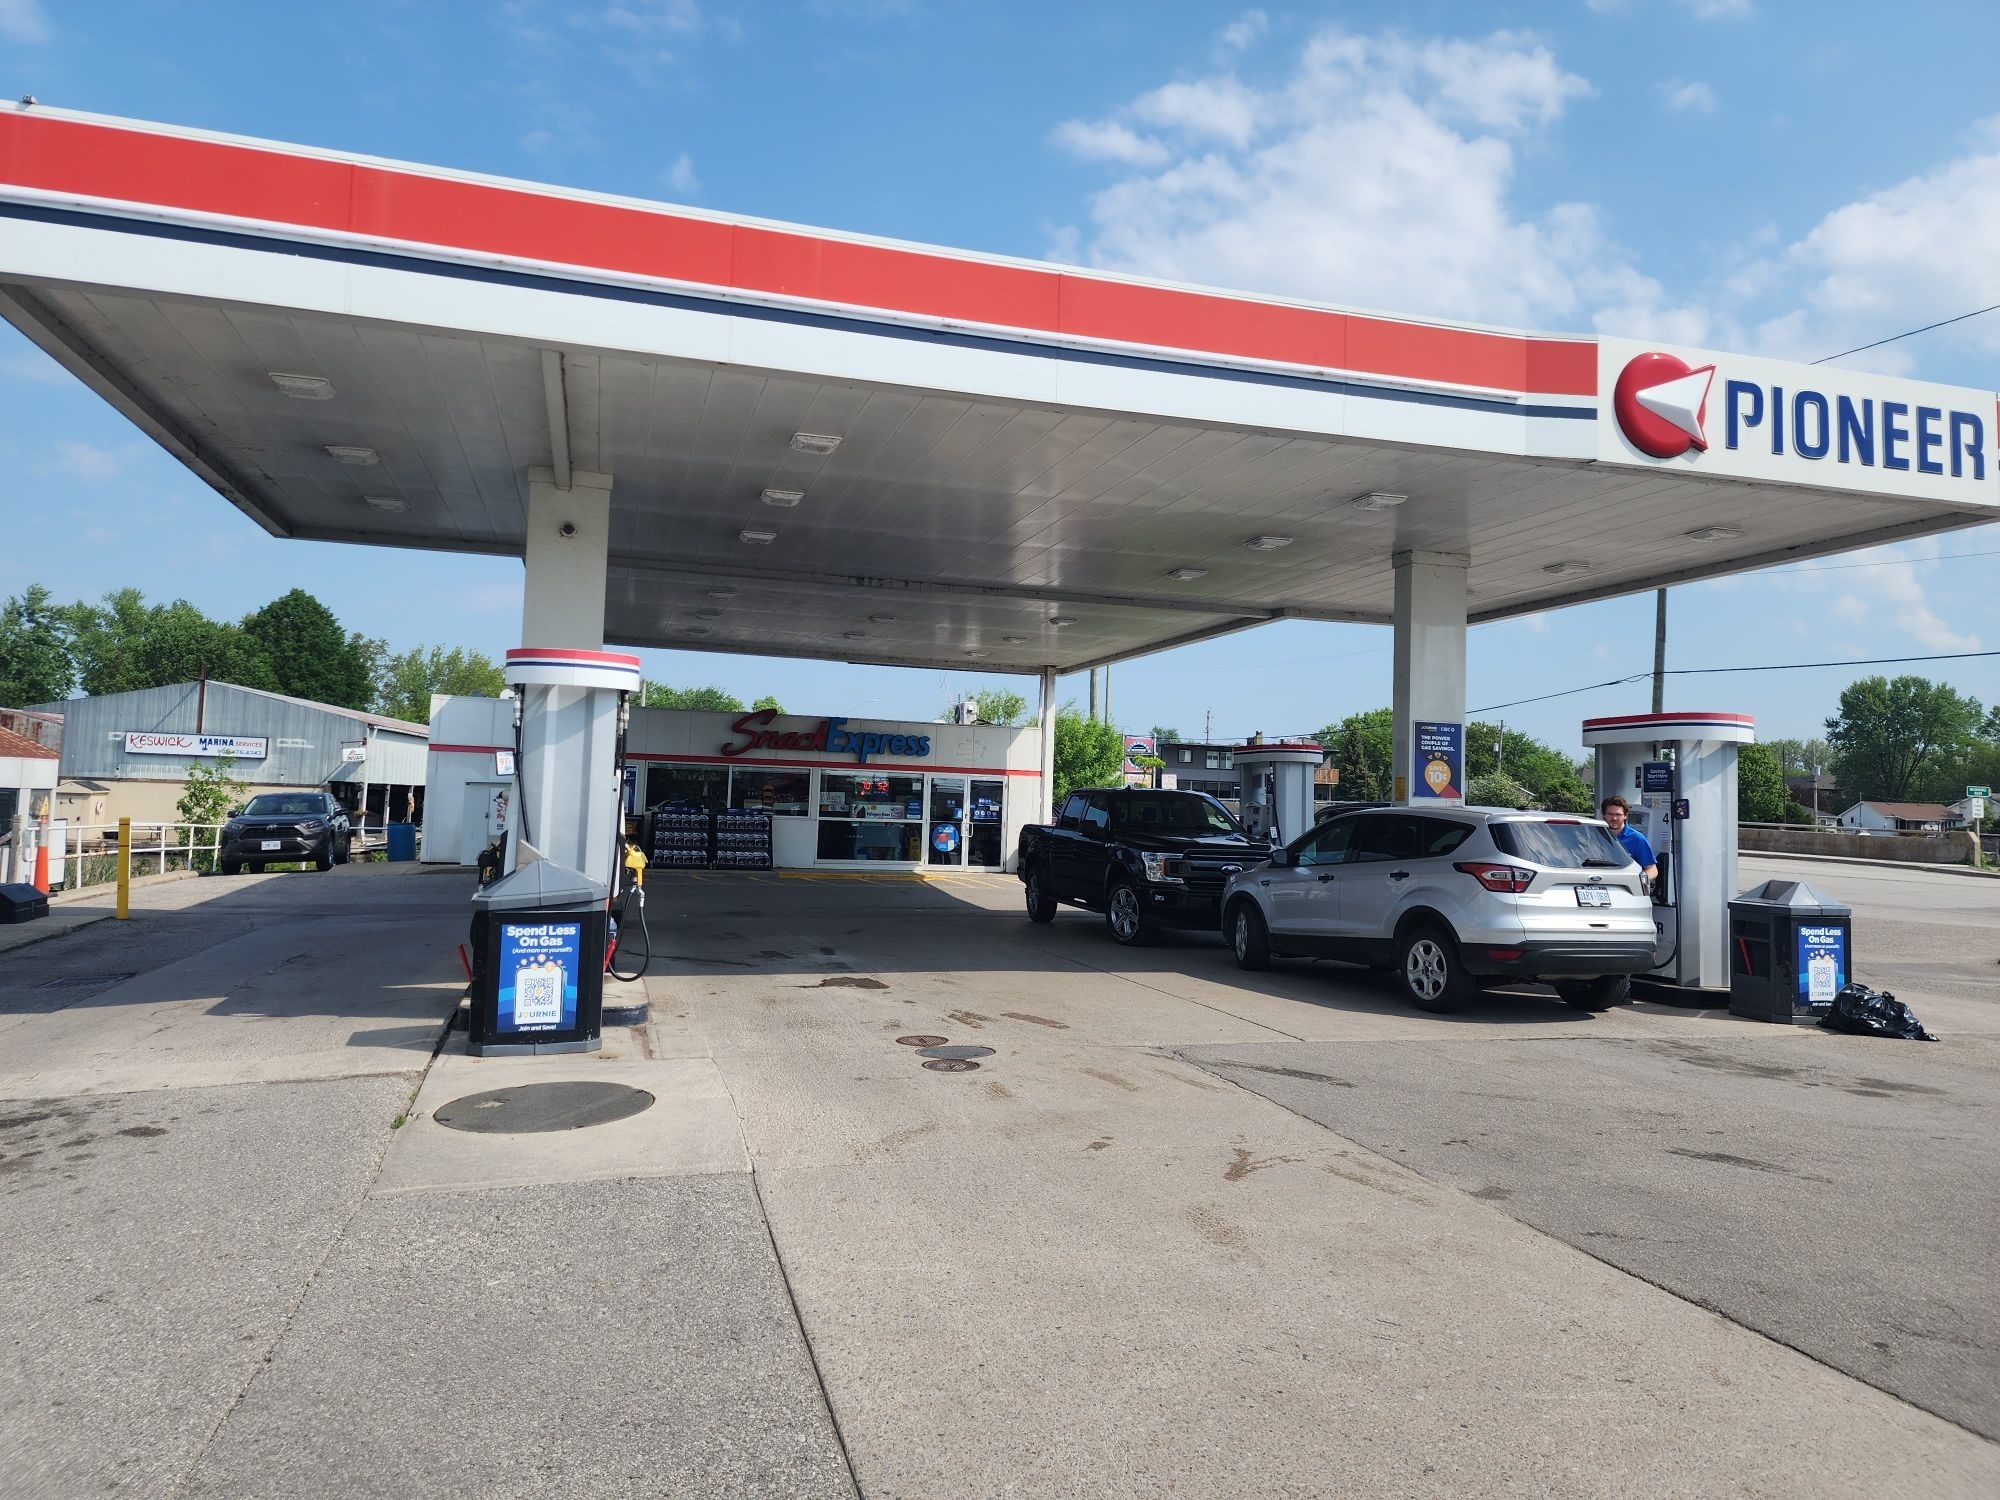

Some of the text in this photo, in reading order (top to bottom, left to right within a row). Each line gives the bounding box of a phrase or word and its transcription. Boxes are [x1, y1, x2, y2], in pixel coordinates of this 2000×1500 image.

[1725, 378, 1985, 480] PIONEER
[721, 708, 930, 764] Snack Express
[130, 734, 192, 748] KESWICK
[199, 738, 234, 750] MARINA
[1663, 813, 1669, 824] 4
[507, 926, 576, 938] Spend Less
[1801, 927, 1841, 936] Spend Less
[520, 936, 563, 947] On Gas
[1808, 936, 1834, 944] On Gas
[517, 1010, 557, 1019] JOURNIE
